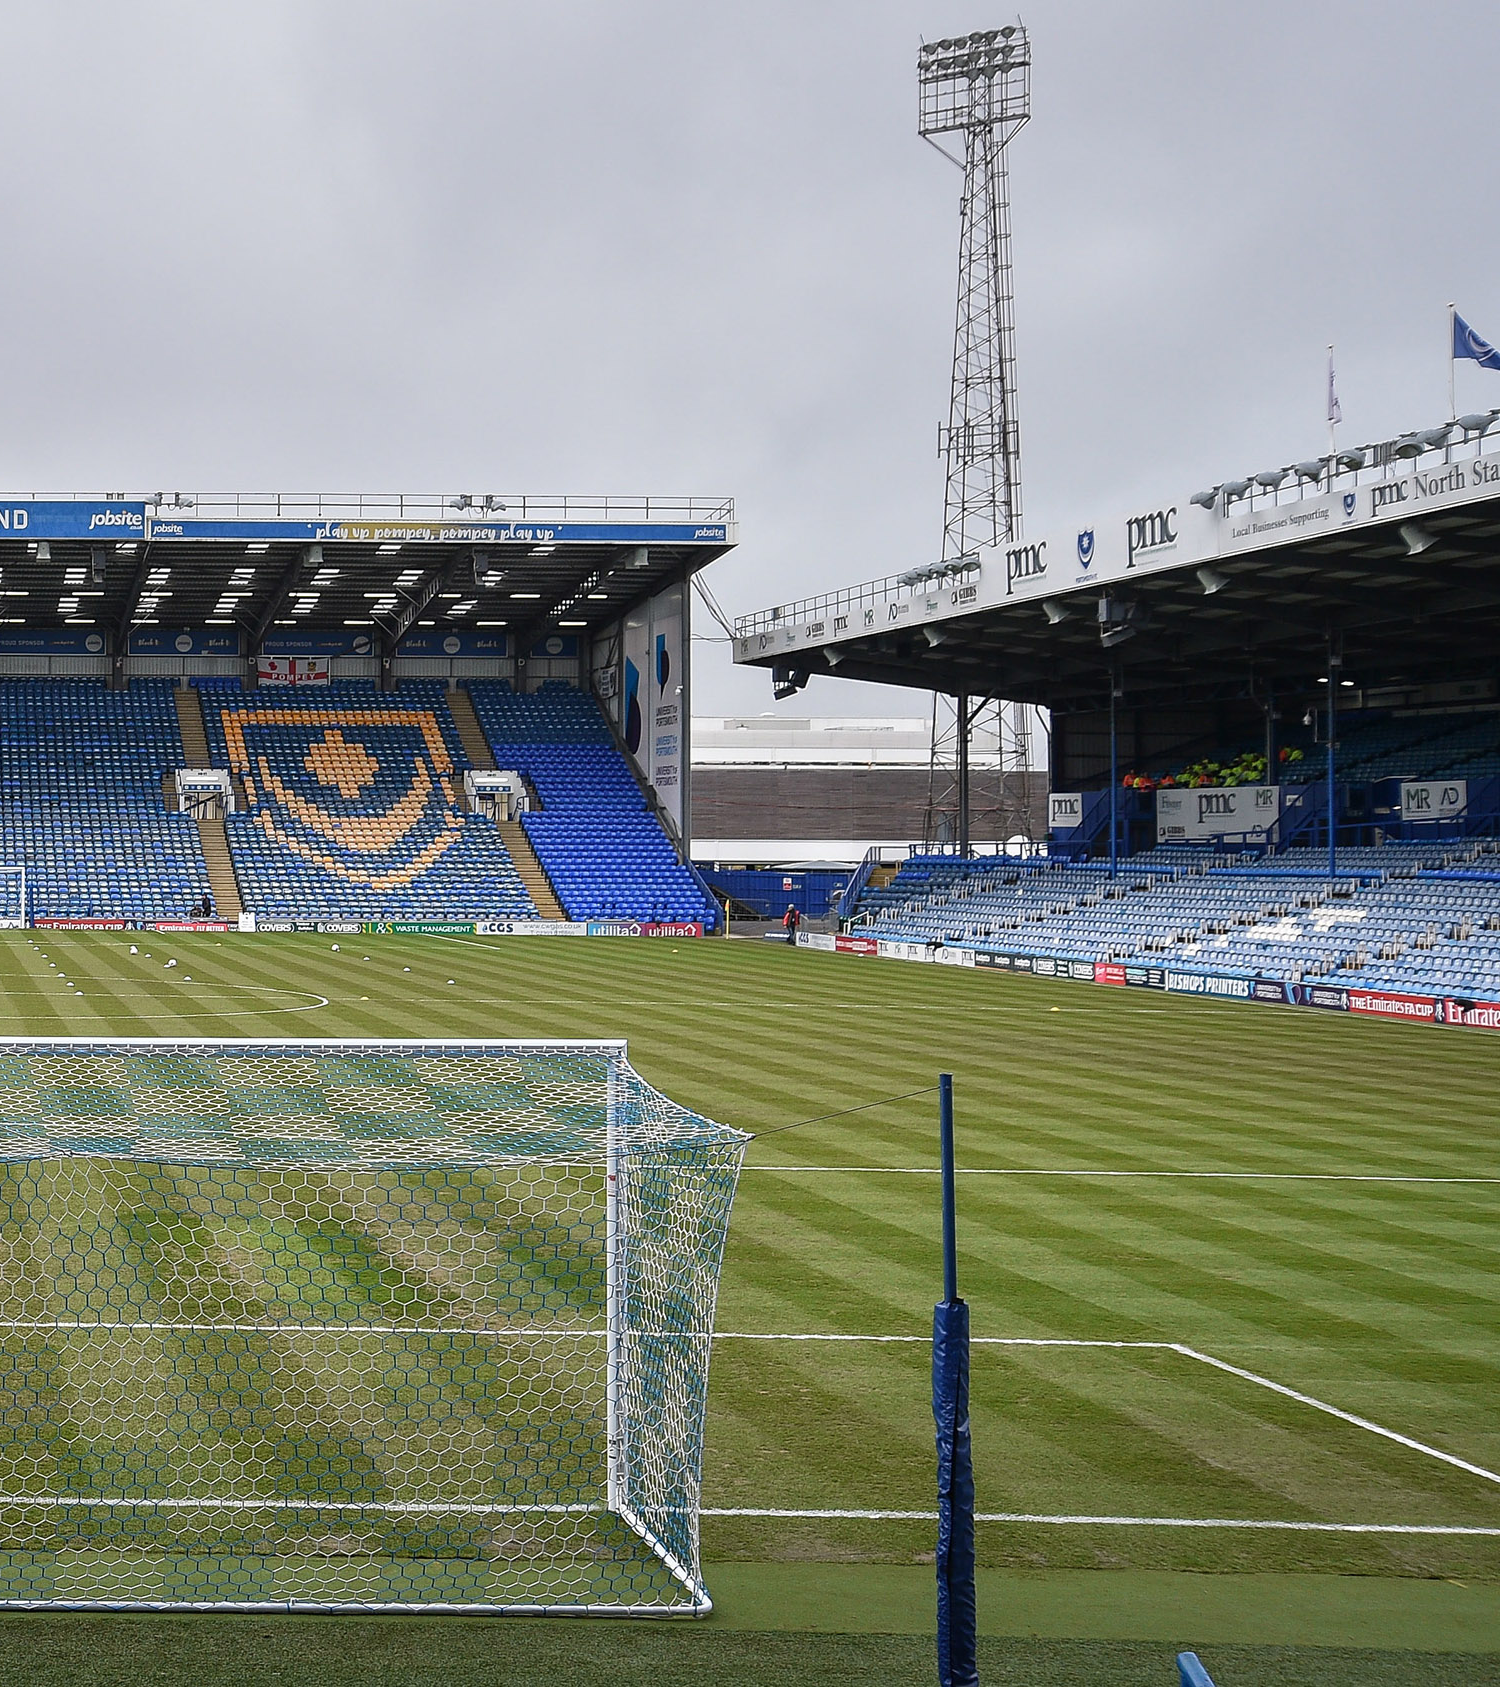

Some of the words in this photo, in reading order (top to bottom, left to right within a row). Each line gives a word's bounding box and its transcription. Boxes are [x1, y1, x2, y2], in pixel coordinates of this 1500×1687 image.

[1371, 480, 1408, 518] pmc
[1413, 465, 1466, 500] North
[89, 510, 142, 530] jobsite
[153, 524, 183, 534] jobsite
[1232, 525, 1250, 538] Local
[1253, 517, 1287, 533] Businesses
[1289, 508, 1329, 526] Supporting
[315, 522, 349, 539] play
[352, 528, 369, 539] up
[374, 528, 435, 540] pompey,
[439, 528, 496, 540] pompey
[500, 523, 533, 540] play
[536, 529, 554, 541] up
[694, 527, 724, 539] jobsite
[1126, 507, 1178, 568] pmc
[1006, 541, 1048, 595] pmc
[833, 615, 848, 637] pmc
[272, 673, 315, 682] POMPEY
[1254, 789, 1273, 806] MR
[1407, 788, 1430, 810] MR
[1052, 798, 1078, 822] pmc
[1198, 793, 1236, 823] pmc
[53, 922, 93, 930] Emirates
[259, 923, 292, 932] COVERS
[326, 924, 358, 932] COVERS
[368, 922, 393, 934] L&S
[489, 923, 514, 932] CGS
[593, 925, 630, 936] utilita
[649, 925, 684, 936] utilita
[1168, 974, 1204, 992] BISHOPS
[1206, 977, 1248, 996] PRINTERS
[1350, 996, 1366, 1009] THE
[1367, 996, 1404, 1014] Emirates
[1405, 1004, 1415, 1016] FA
[1416, 1004, 1434, 1016] CUP
